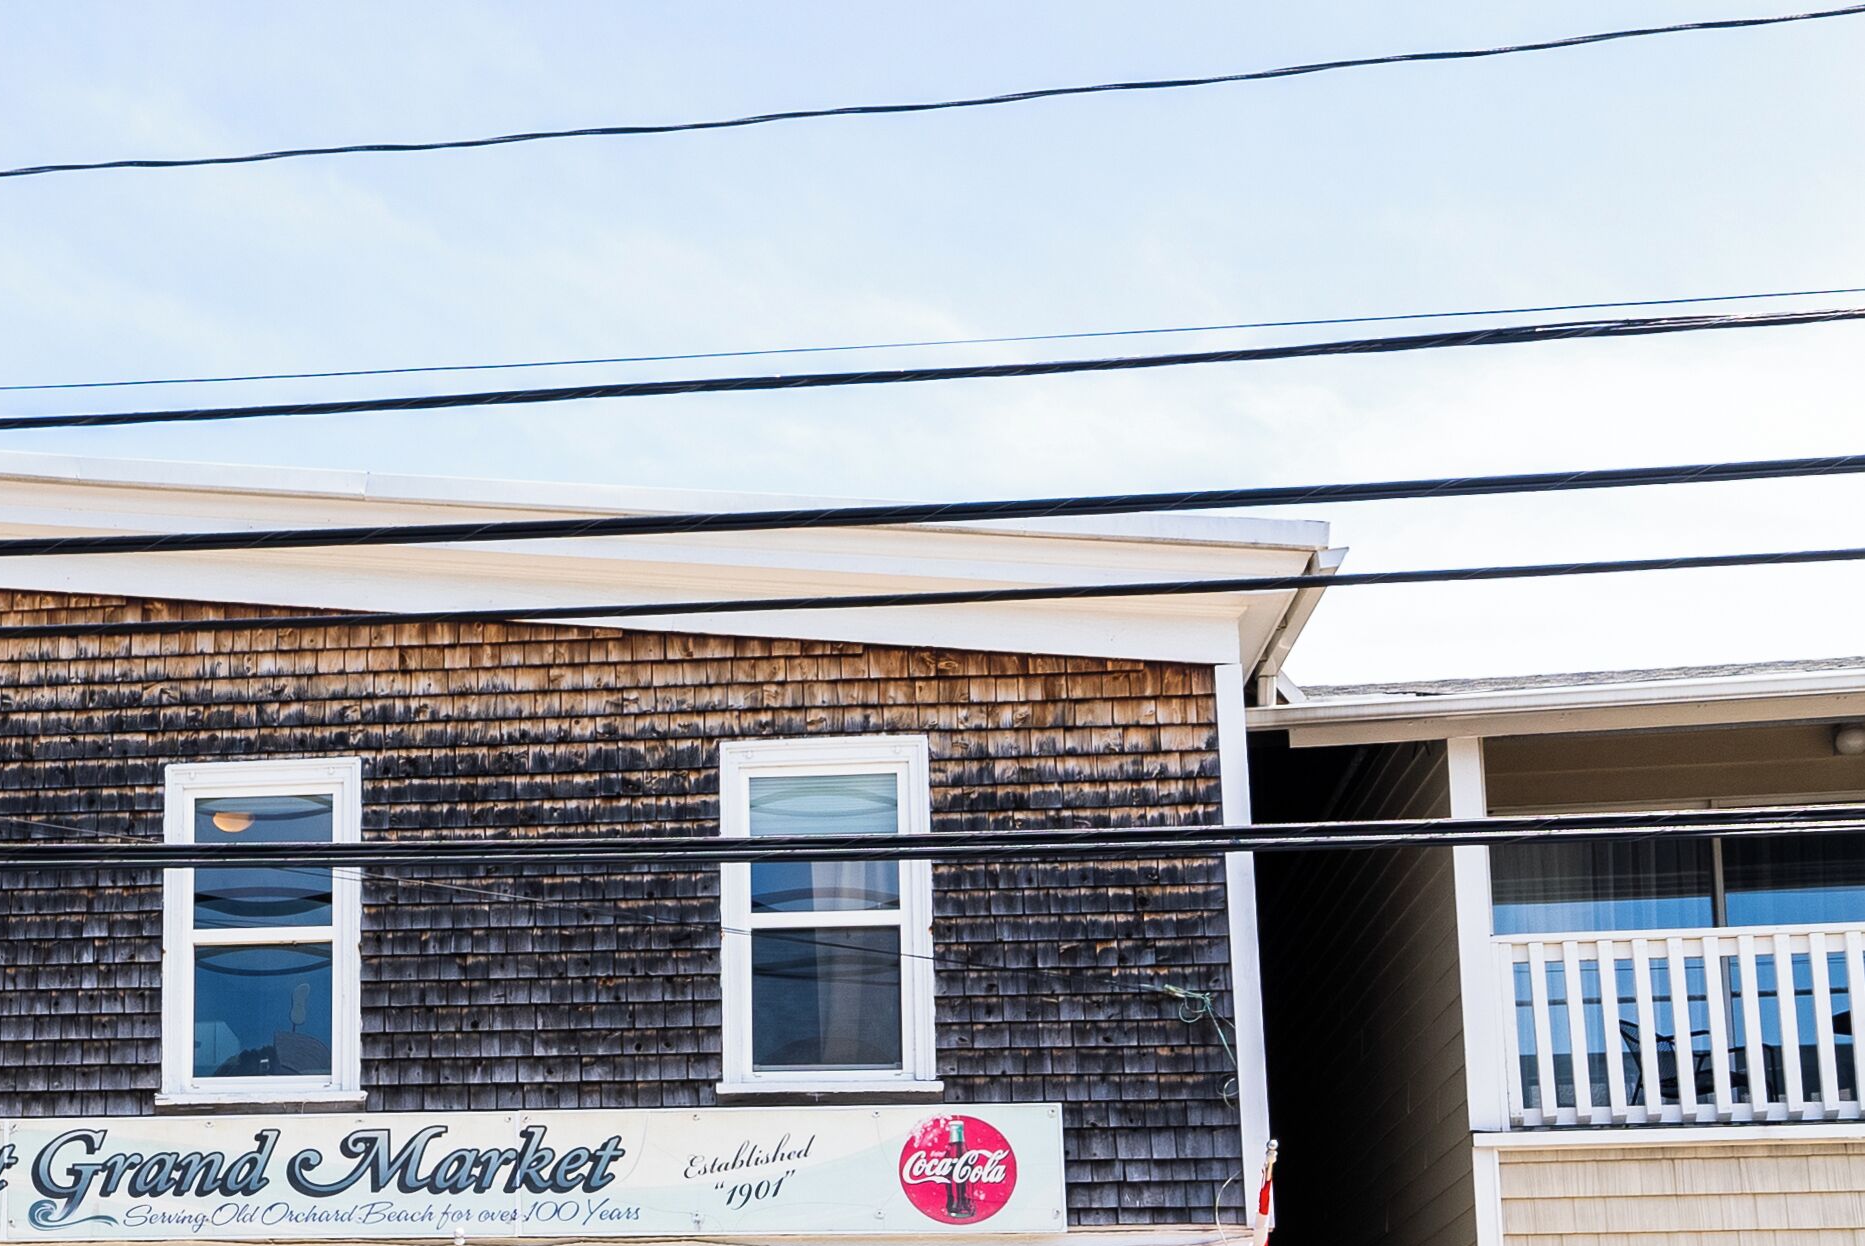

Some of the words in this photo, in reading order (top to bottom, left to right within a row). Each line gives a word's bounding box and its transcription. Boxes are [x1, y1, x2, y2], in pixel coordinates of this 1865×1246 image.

[29, 1128, 281, 1226] Grand
[286, 1125, 625, 1198] Market
[684, 1132, 816, 1179] Established
[902, 1149, 1010, 1184] Coca-Cola
[123, 1204, 207, 1233] Serving
[211, 1202, 260, 1226] Old
[261, 1201, 357, 1225] Orchard
[360, 1200, 433, 1225] Beach
[436, 1203, 471, 1230] for
[478, 1208, 518, 1223] over
[523, 1201, 579, 1223] 100
[580, 1198, 640, 1226] Years
